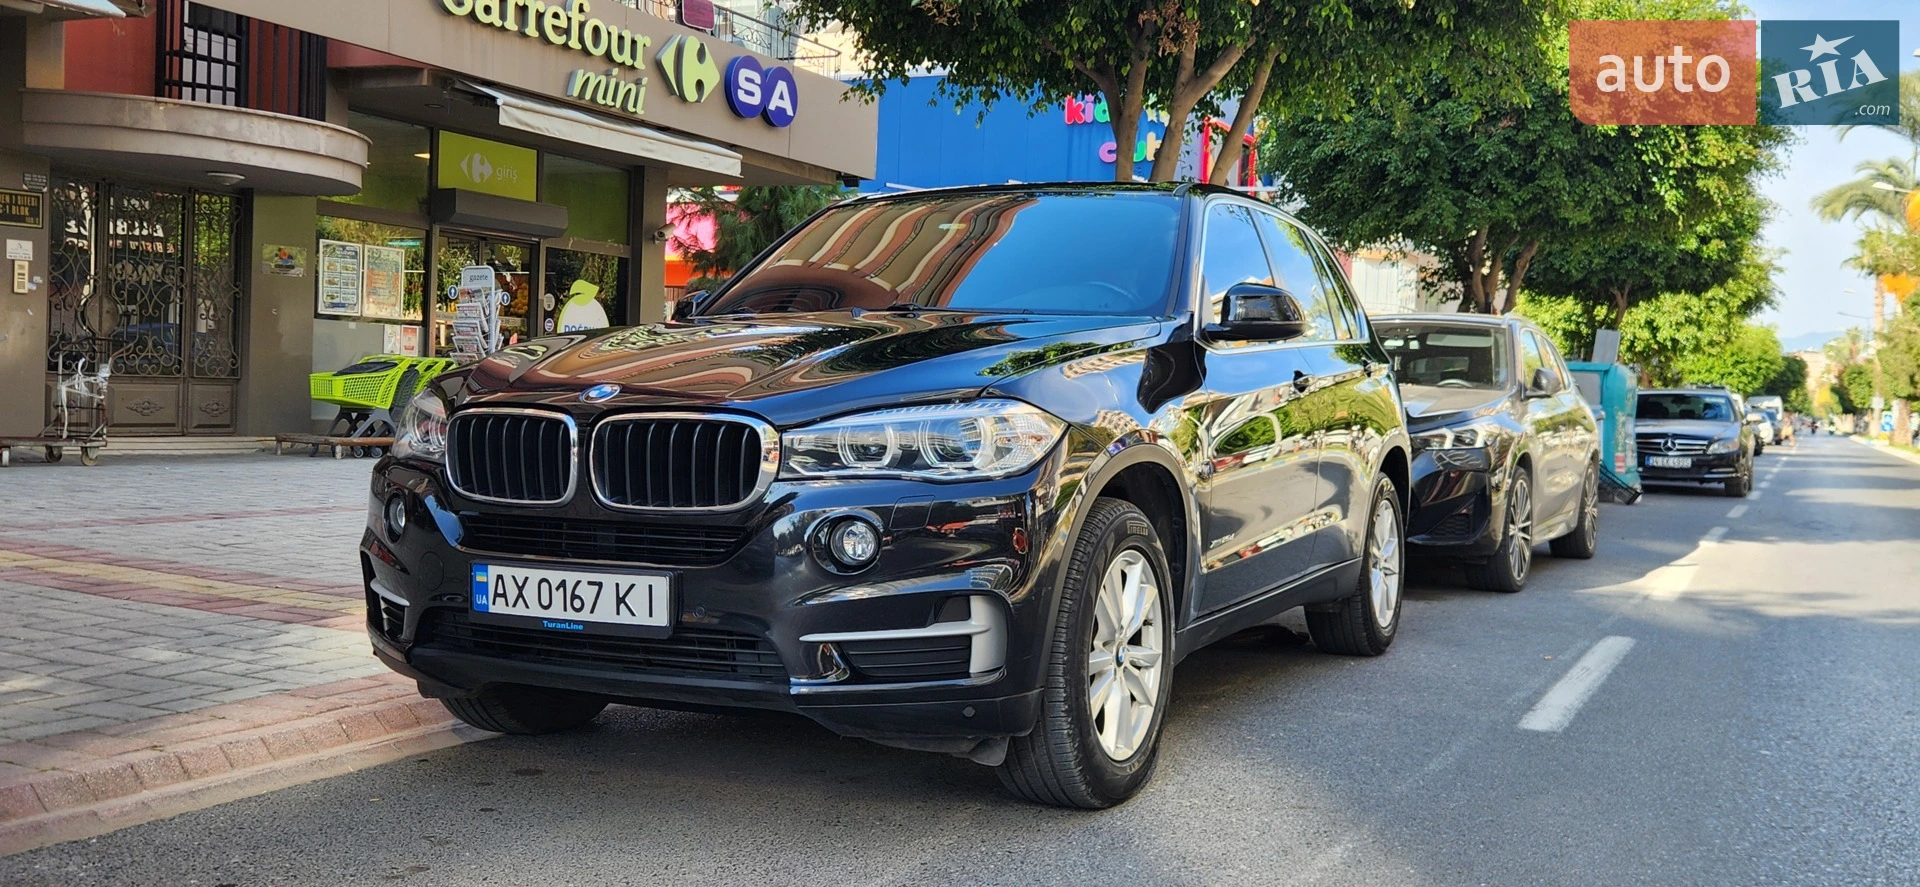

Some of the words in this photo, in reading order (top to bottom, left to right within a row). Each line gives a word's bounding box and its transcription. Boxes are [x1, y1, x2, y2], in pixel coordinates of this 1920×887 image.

[570, 68, 648, 115] mini
[1099, 131, 1163, 163] cub
[496, 164, 518, 184] giriş
[469, 274, 489, 283] gazete
[475, 594, 488, 606] UA
[491, 573, 531, 609] AX
[537, 577, 604, 614] 0167
[542, 620, 584, 631] TuranLine
